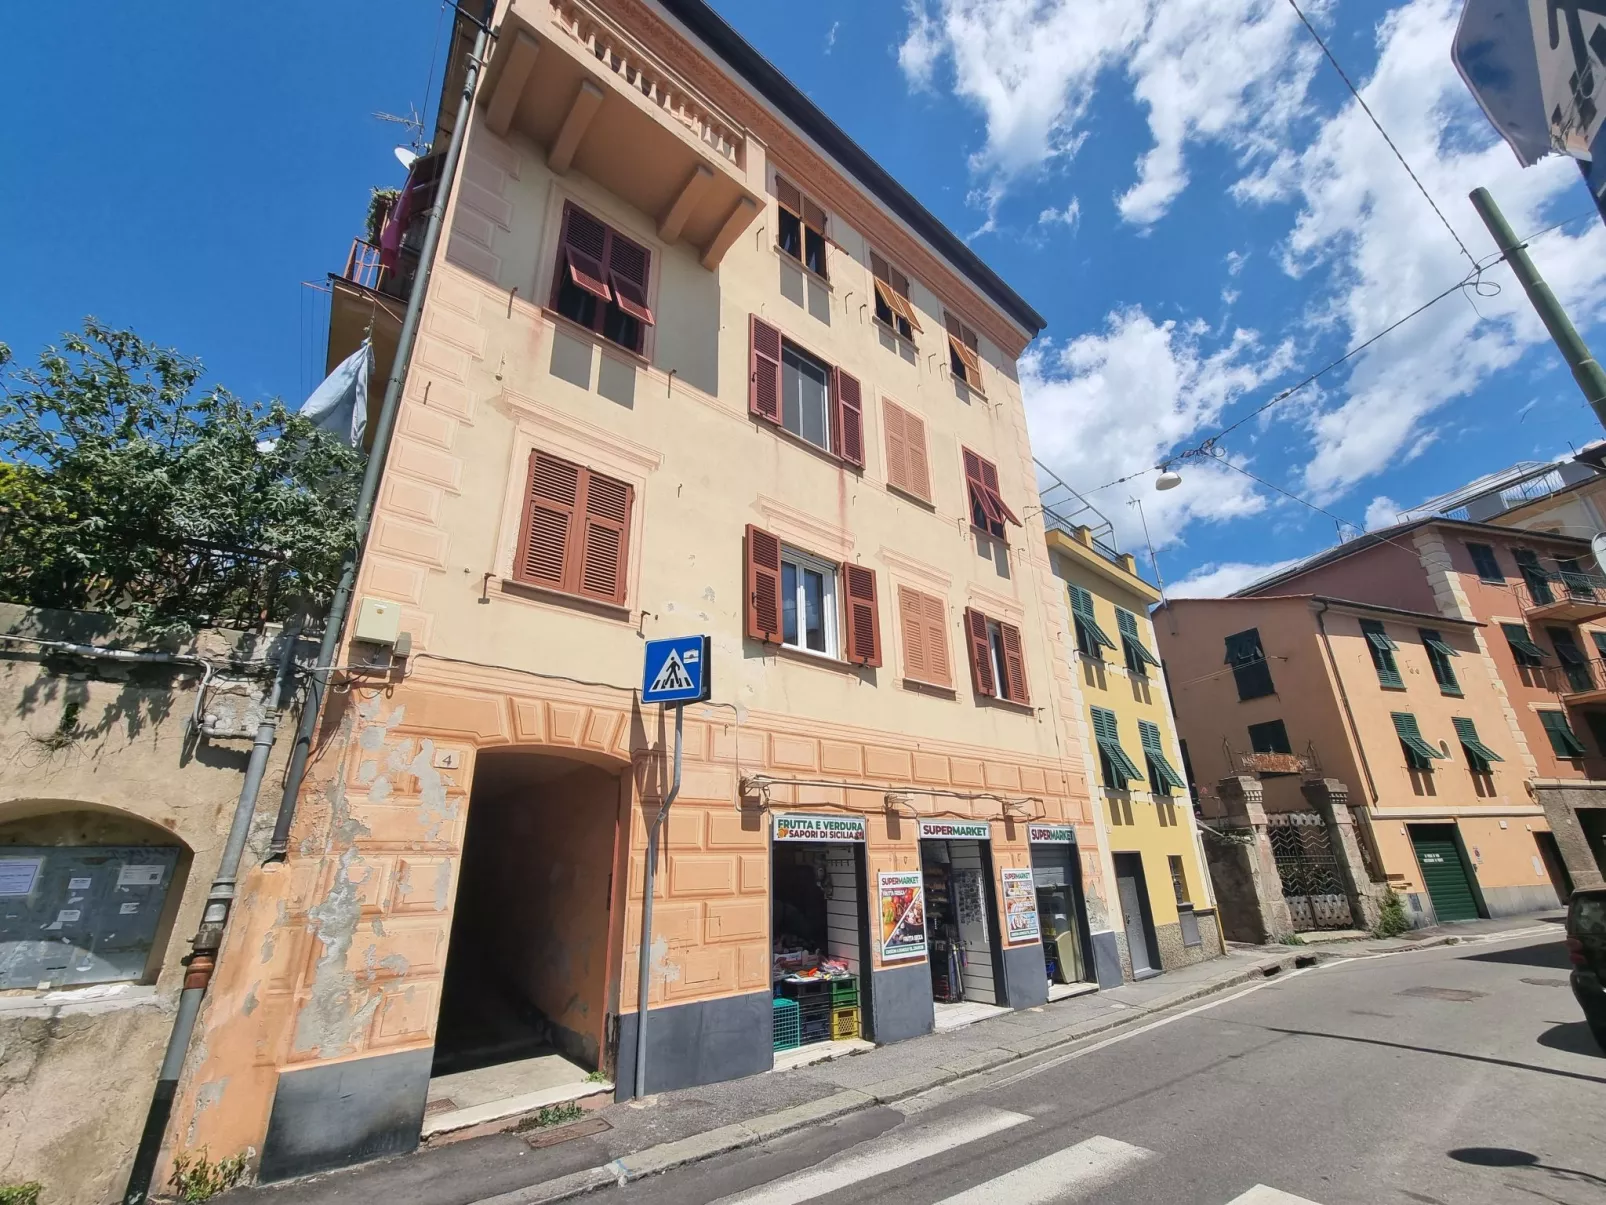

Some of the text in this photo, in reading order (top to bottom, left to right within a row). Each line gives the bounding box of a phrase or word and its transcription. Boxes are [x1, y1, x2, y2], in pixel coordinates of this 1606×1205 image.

[442, 754, 452, 767] 4
[778, 819, 863, 830] FRUTTA E VERDURA
[789, 830, 818, 838] SAPORI
[829, 831, 854, 839] SICILIA
[923, 825, 986, 836] SUPERMARKET
[1031, 829, 1073, 840] SUPERMARKET
[881, 877, 919, 886] SUPERMARKET
